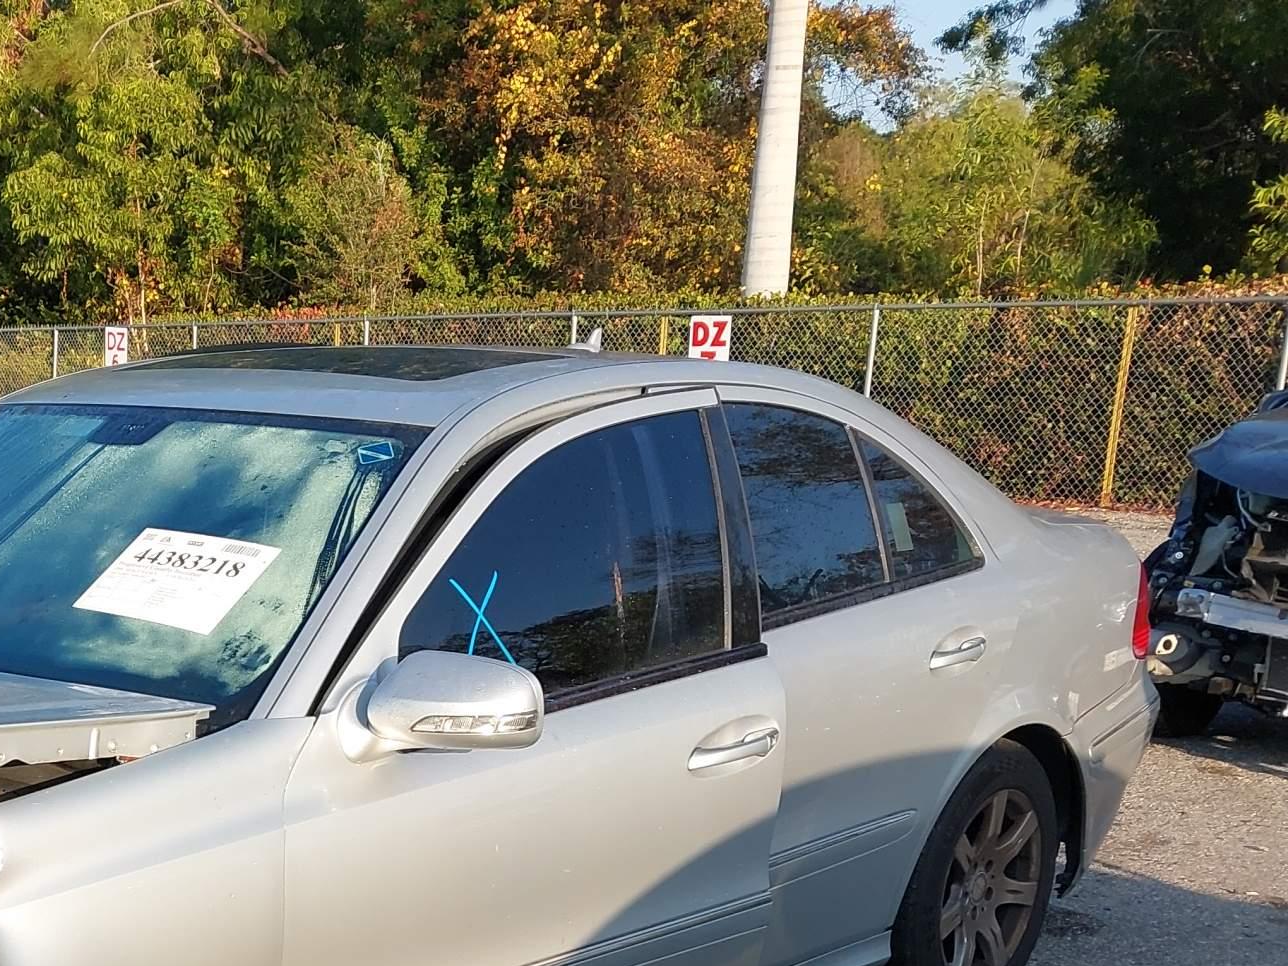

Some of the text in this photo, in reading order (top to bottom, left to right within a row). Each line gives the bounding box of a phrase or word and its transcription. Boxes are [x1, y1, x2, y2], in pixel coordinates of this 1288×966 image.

[107, 332, 125, 351] DZ
[692, 321, 728, 346] DZ
[134, 548, 245, 577] 44383218
